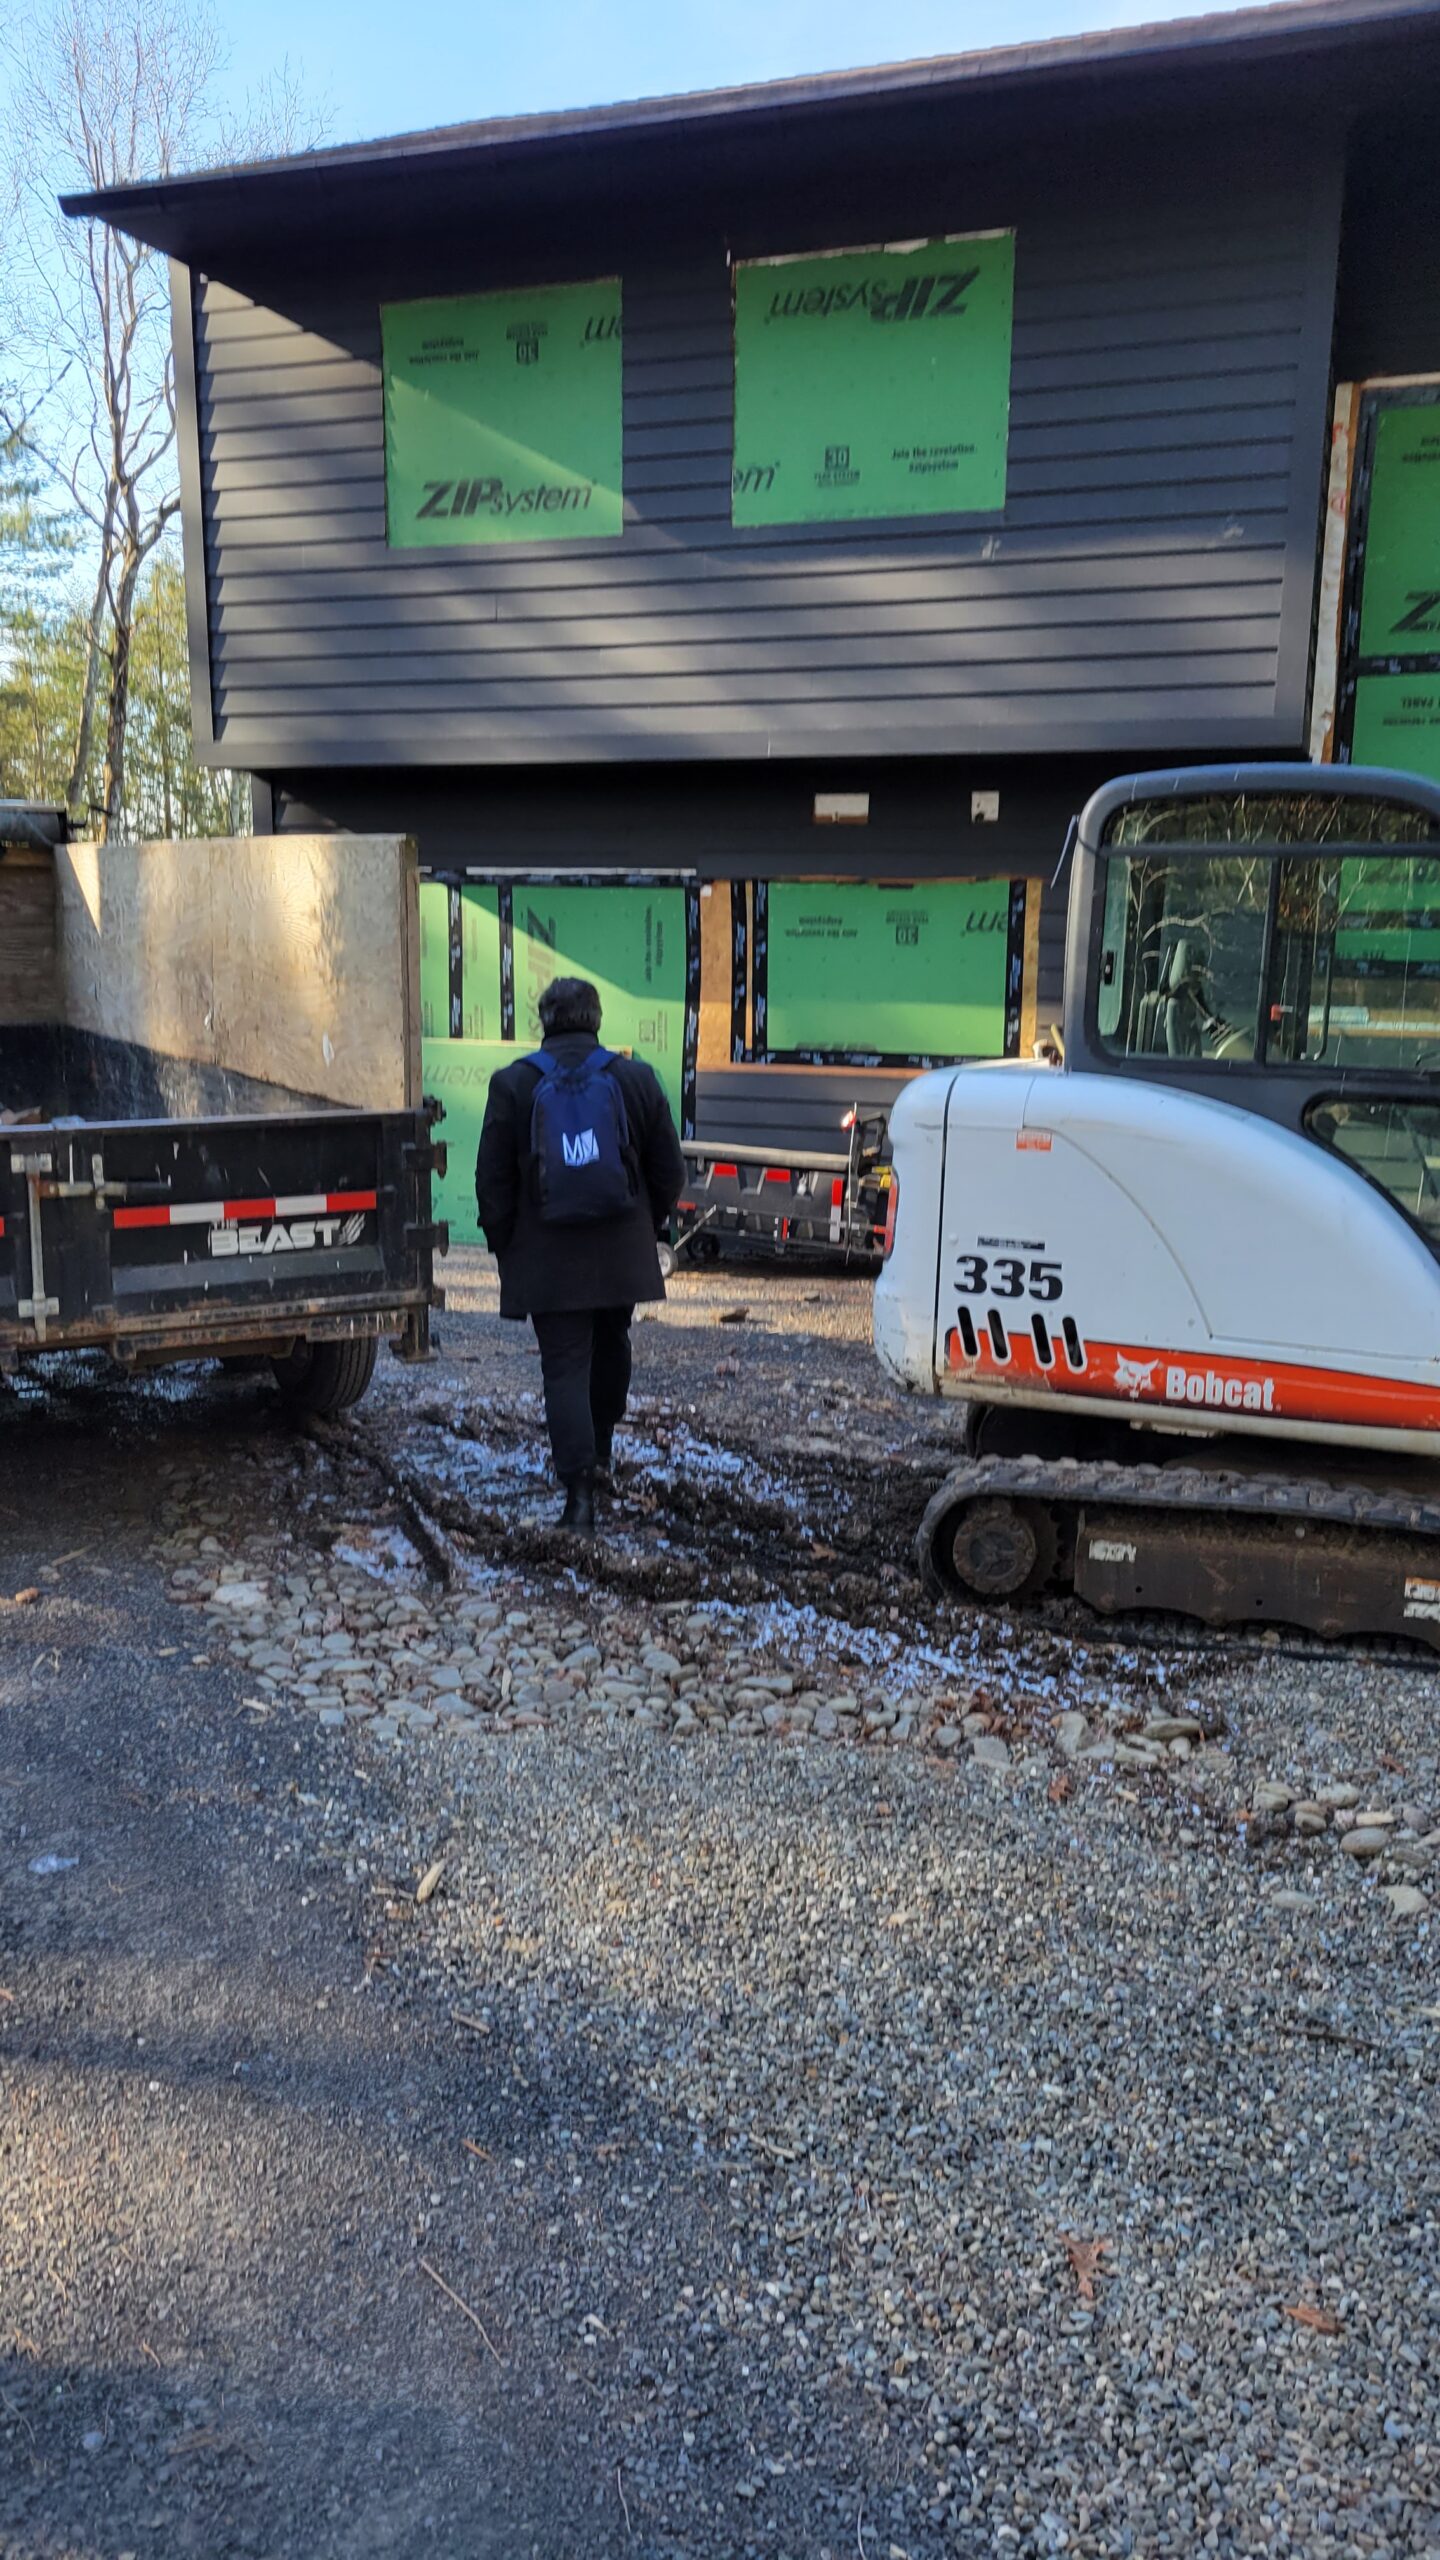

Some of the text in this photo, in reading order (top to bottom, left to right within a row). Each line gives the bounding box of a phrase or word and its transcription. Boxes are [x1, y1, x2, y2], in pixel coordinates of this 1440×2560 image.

[210, 1219, 341, 1257] BEAST
[953, 1255, 1063, 1301] 335
[1166, 1366, 1274, 1412] Bobcat
